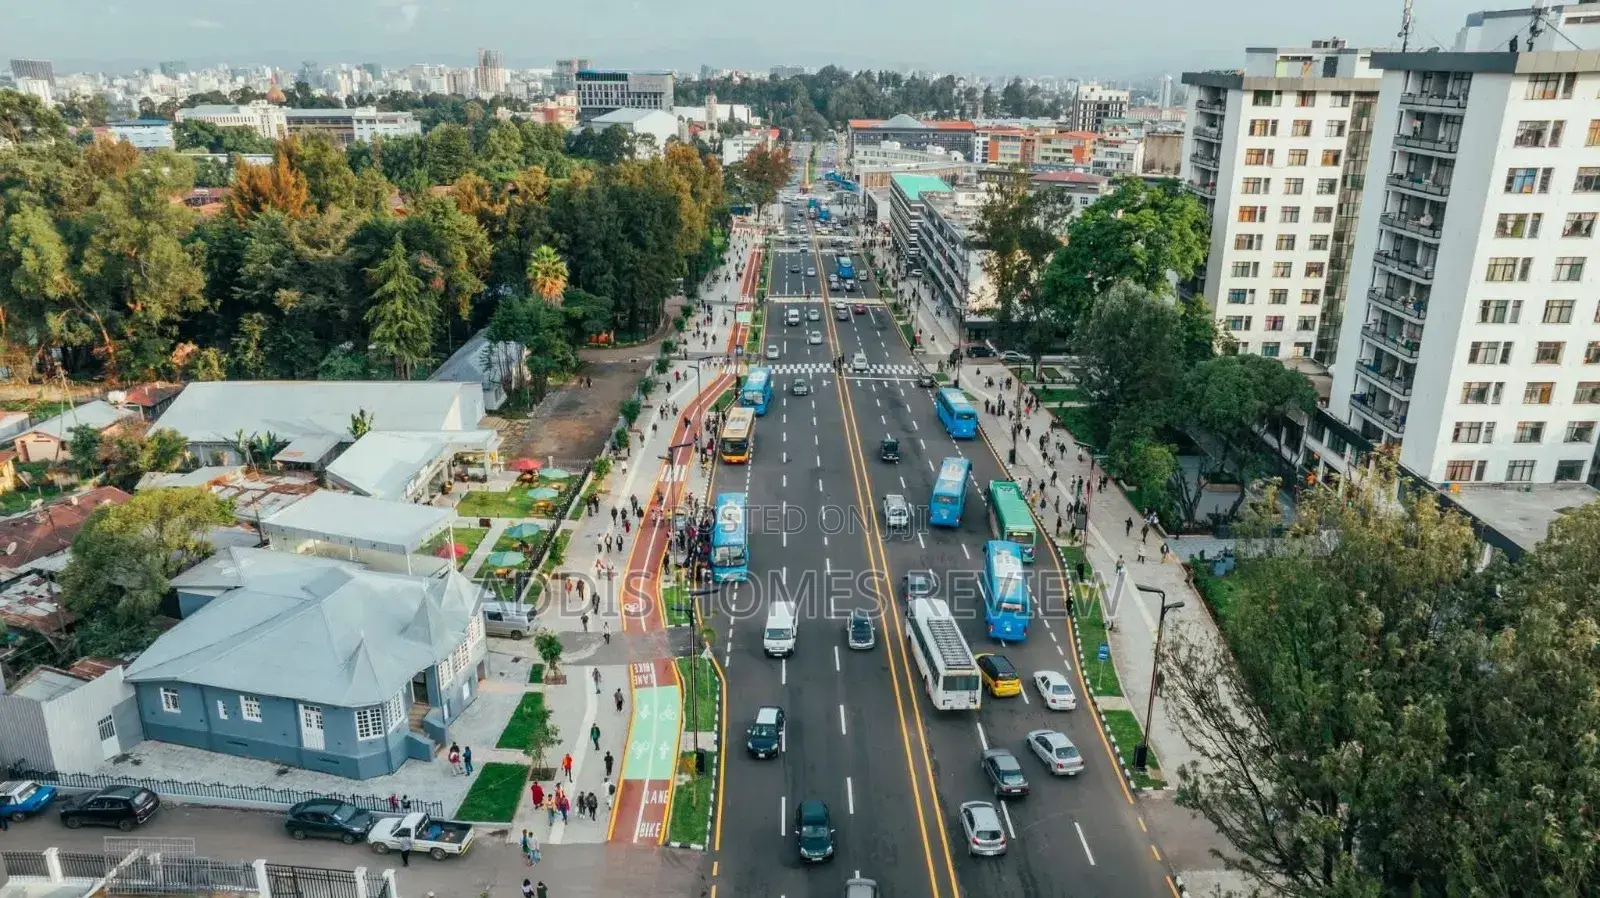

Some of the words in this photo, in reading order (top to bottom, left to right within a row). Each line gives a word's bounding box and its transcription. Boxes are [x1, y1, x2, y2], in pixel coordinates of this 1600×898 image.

[633, 662, 651, 673] BIKE
[645, 790, 669, 804] LANE
[640, 822, 661, 838] BIKE
